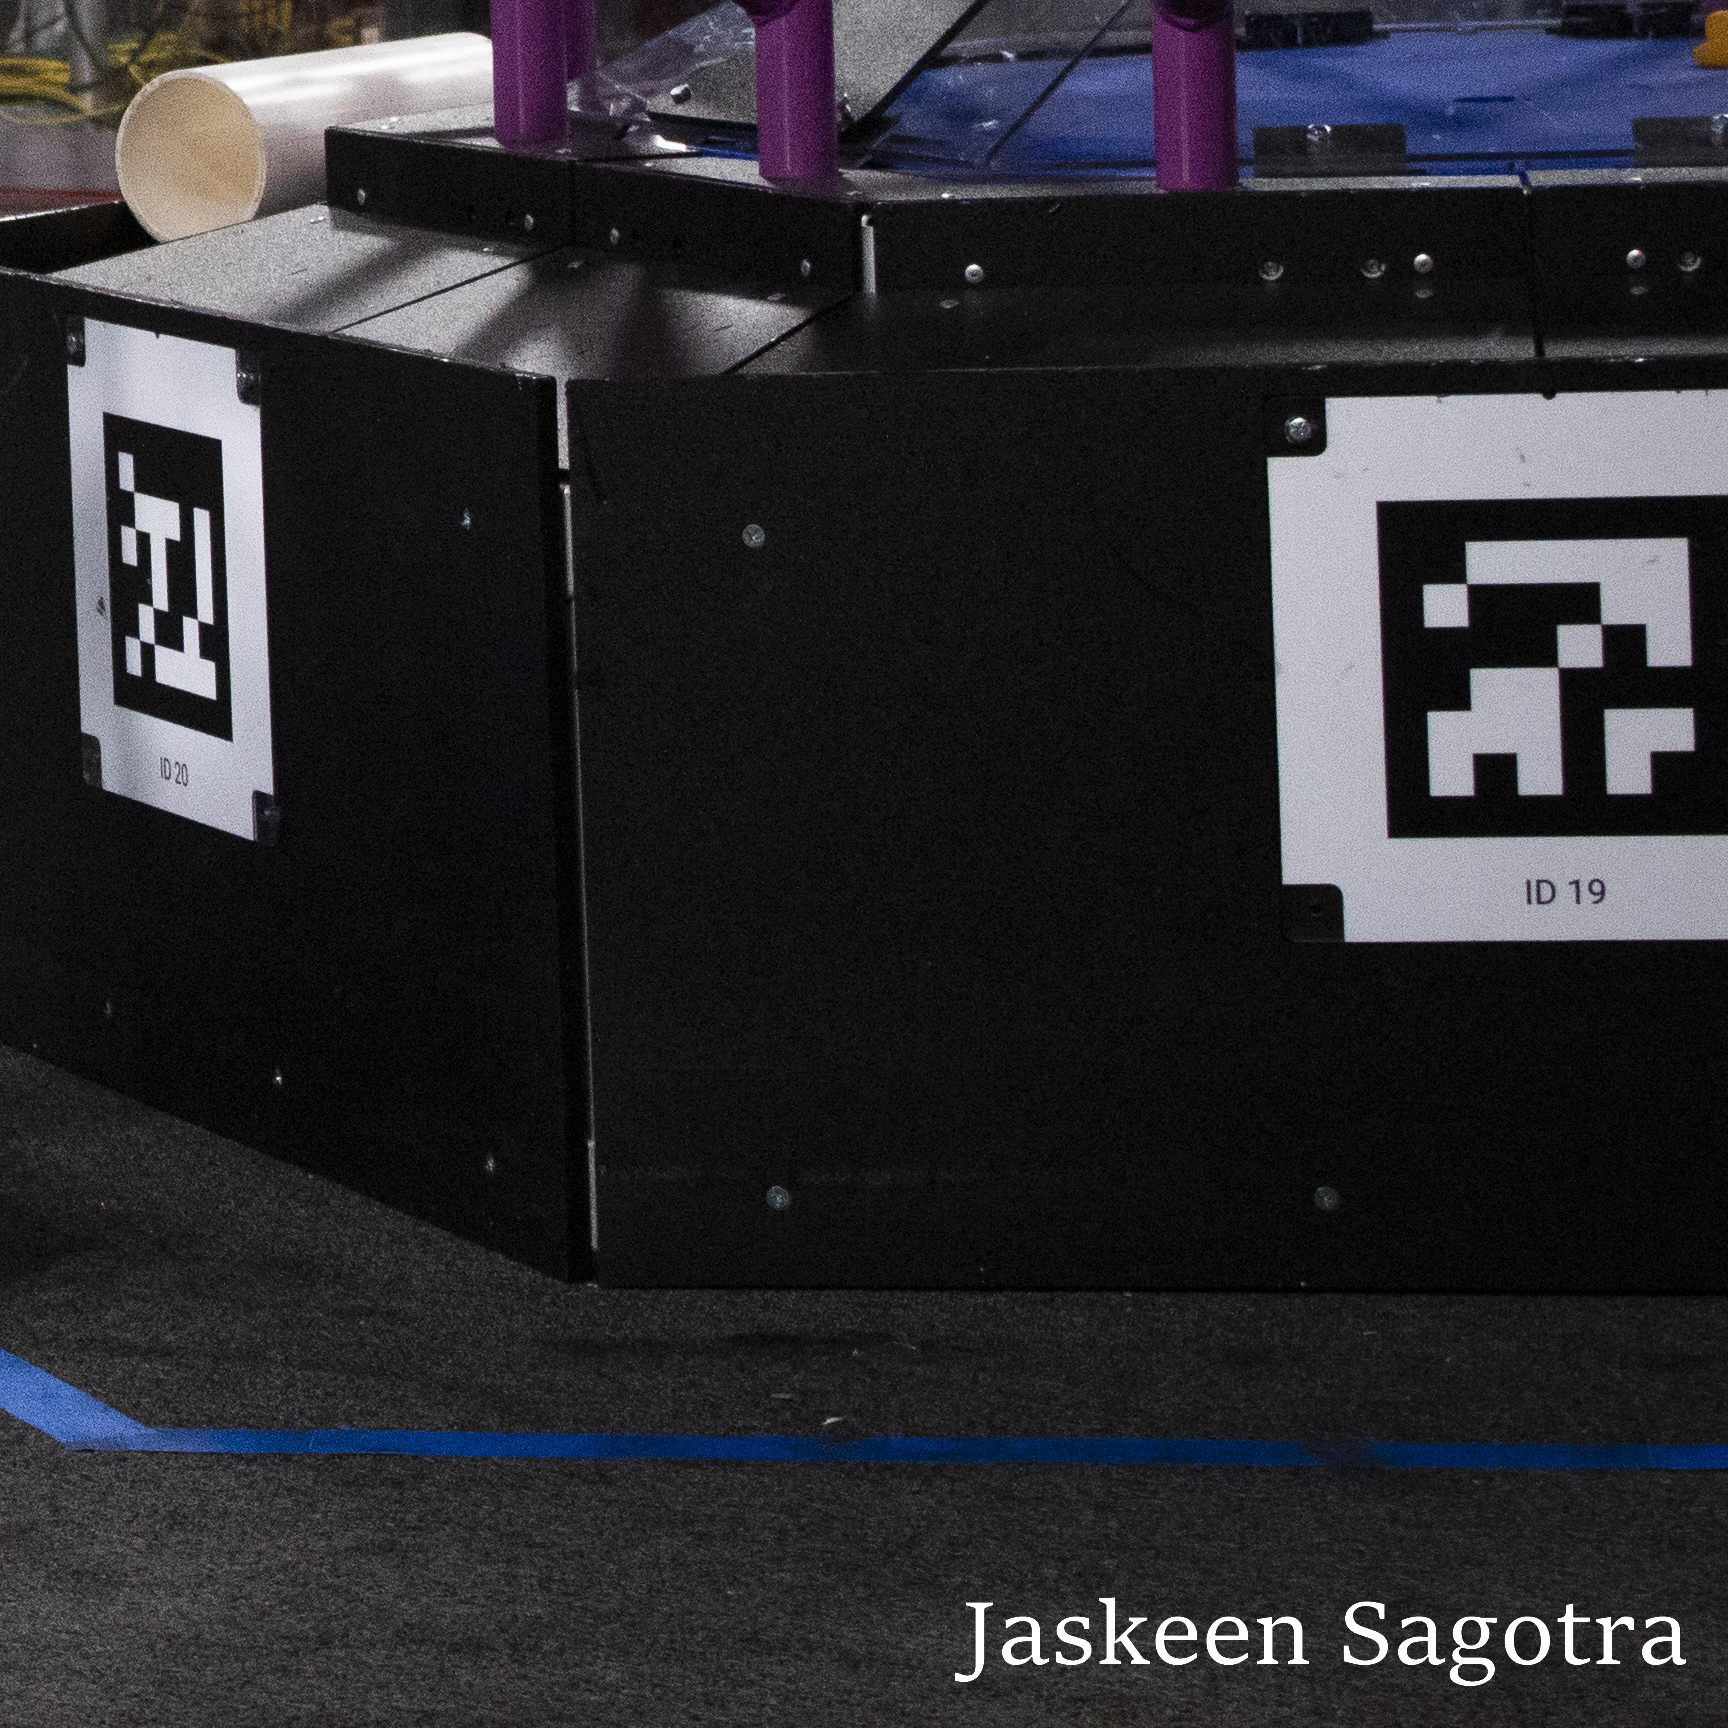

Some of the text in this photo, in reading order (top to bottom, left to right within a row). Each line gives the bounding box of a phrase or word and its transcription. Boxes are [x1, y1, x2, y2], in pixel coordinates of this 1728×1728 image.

[160, 757, 189, 787] ID 20
[1525, 878, 1606, 905] ID 19
